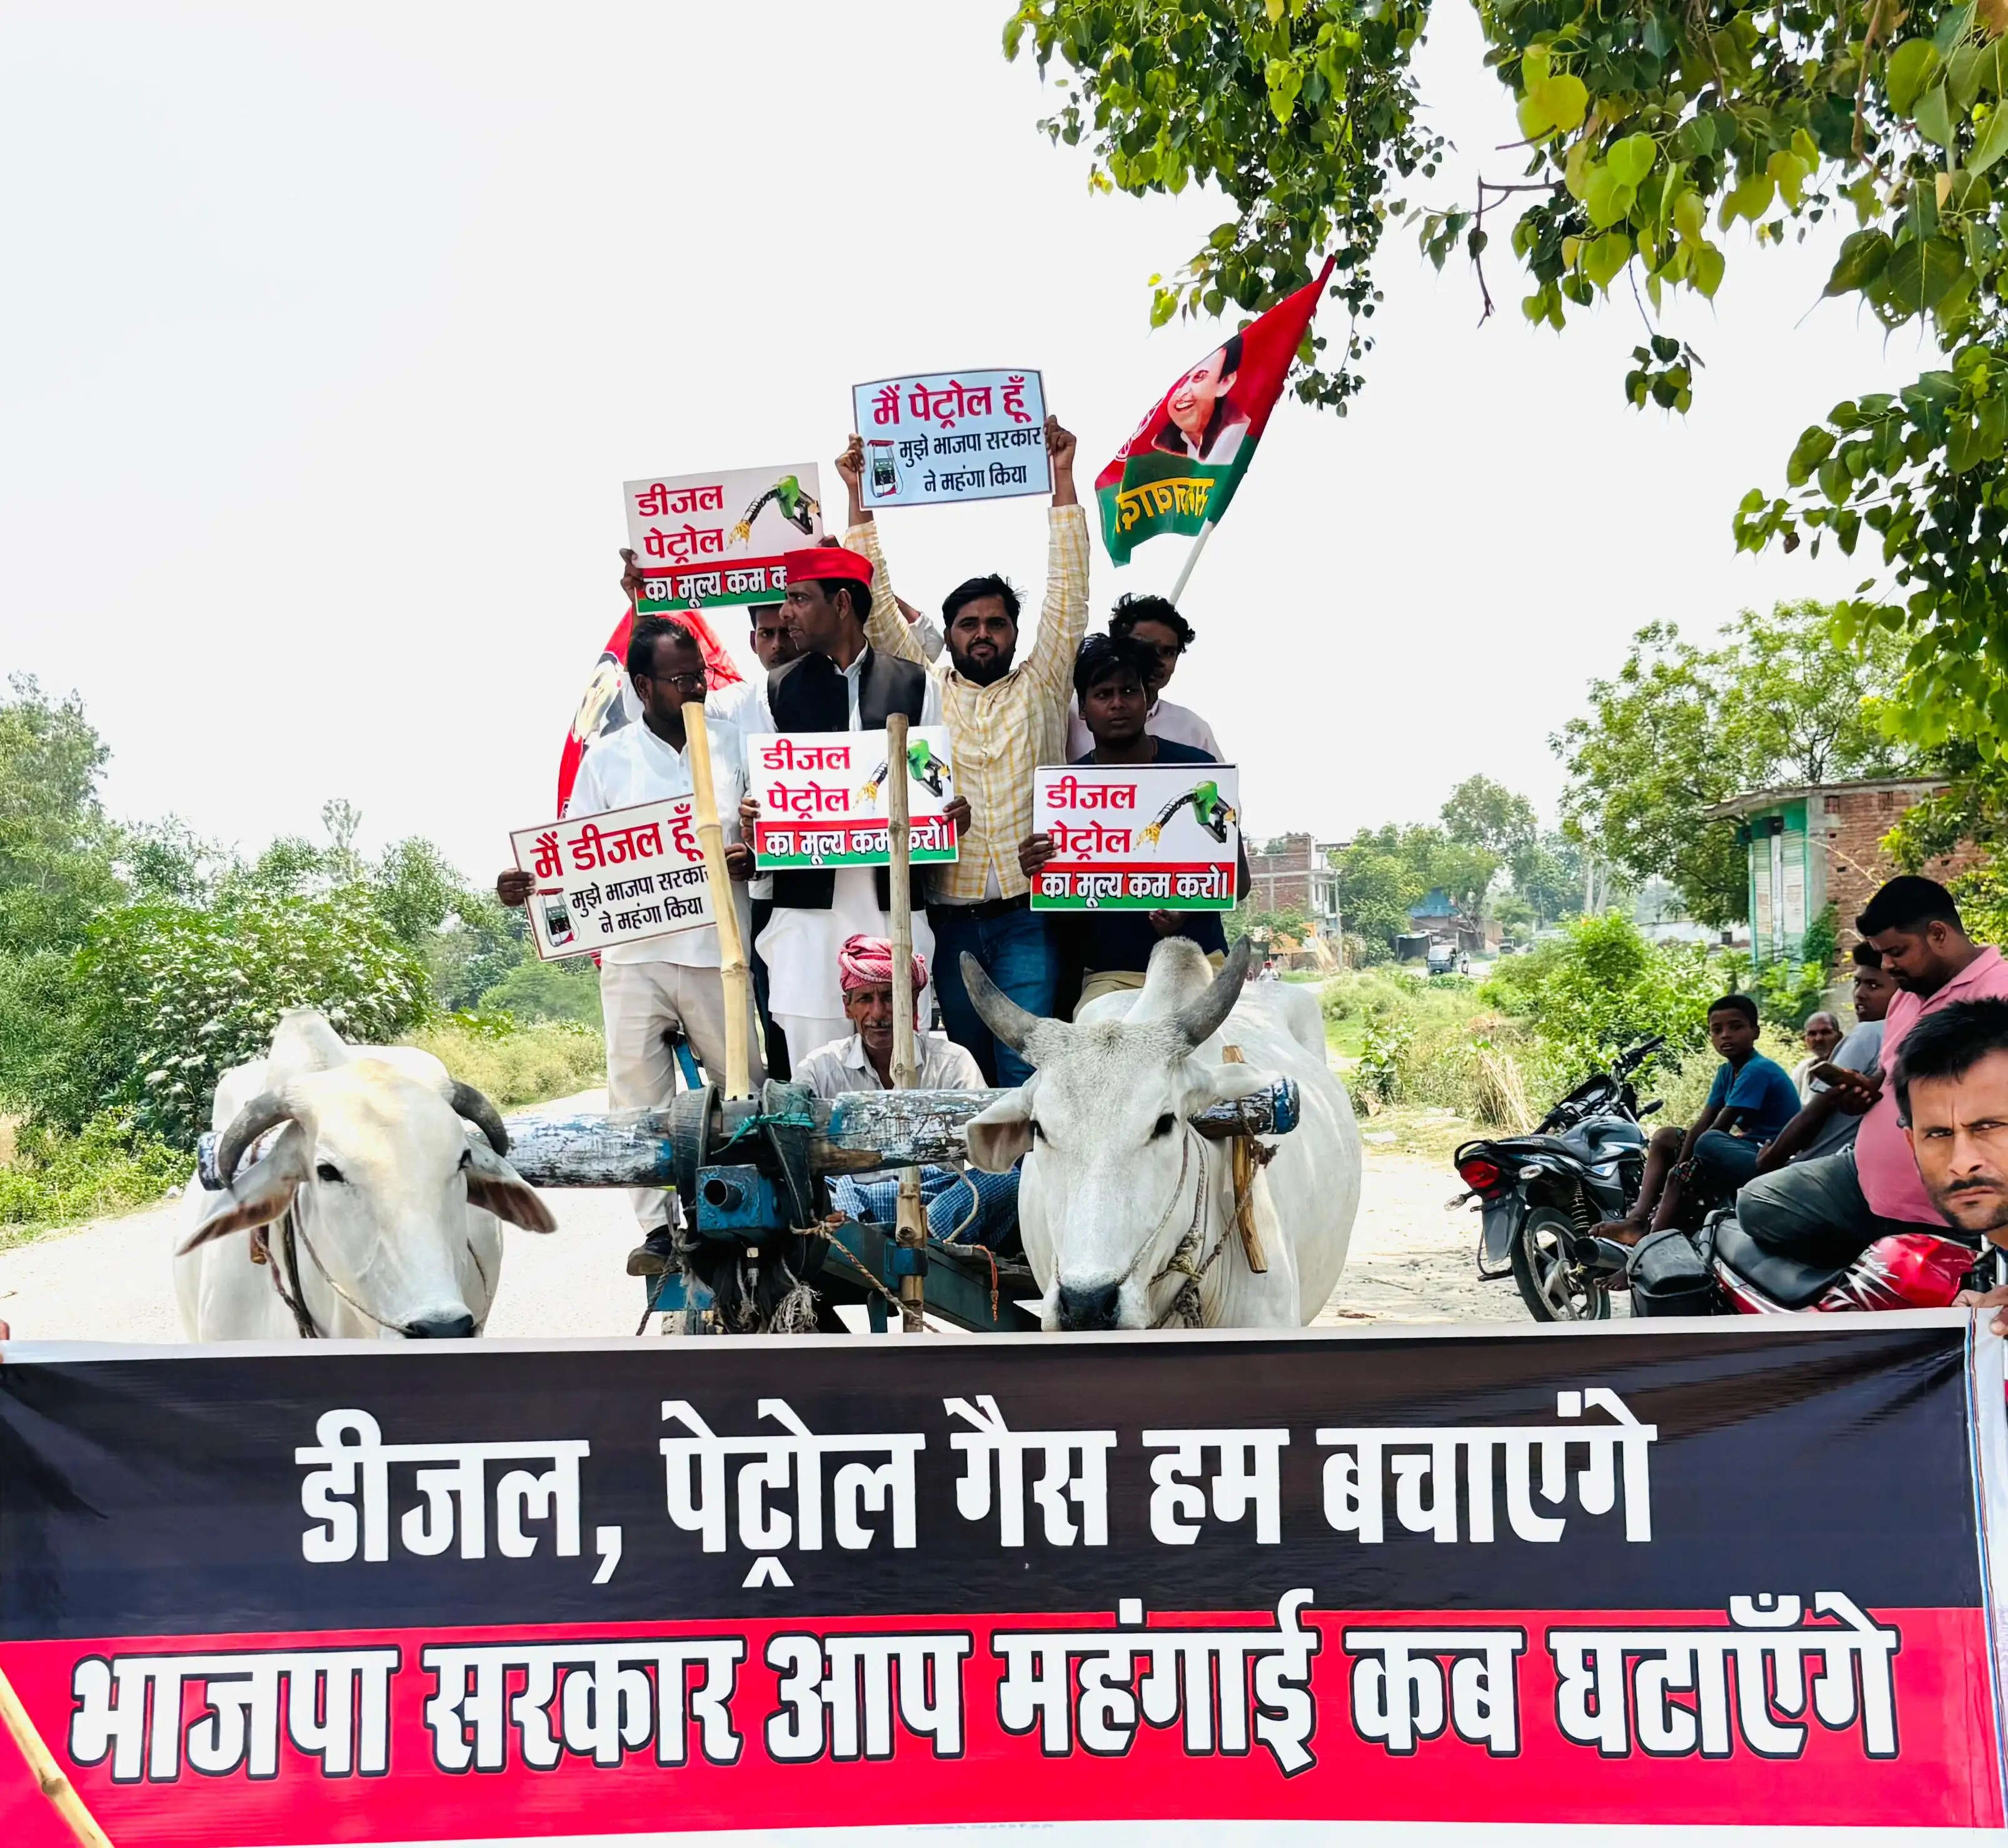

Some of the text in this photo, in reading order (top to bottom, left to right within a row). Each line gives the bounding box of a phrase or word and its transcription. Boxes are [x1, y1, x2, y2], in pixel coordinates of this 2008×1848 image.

[871, 375, 1032, 429] मैं पेट्रोल हूँ
[898, 427, 1042, 467] मुझे भाजपा सरकार
[923, 461, 1027, 492] ने महंगा किया
[635, 483, 723, 517] डीजल
[643, 523, 724, 565] पेट्रोल
[642, 576, 673, 602] का
[676, 571, 721, 609] मूल्य
[725, 566, 766, 594] कम
[760, 738, 851, 770] डीजल
[767, 781, 850, 820] पेट्रोल
[1045, 775, 1137, 810] डीजल
[530, 803, 704, 878] मैं डीजल हूँ
[763, 831, 795, 857] का
[799, 830, 846, 866] मूल्य
[850, 828, 890, 855] कम
[1047, 820, 1132, 860] पेट्रोल
[570, 882, 601, 918] मुझे
[605, 875, 655, 902] भाजपा
[1040, 863, 1228, 908] का मूल्य कम करो।
[599, 896, 703, 933] ने महंगा किया
[294, 1387, 1658, 1588] डीजल, पेट्रोल गैस हम बचाएंगे
[69, 1588, 1900, 1784] भाजपा सरकार आप महंगाई कब घटाएँगे
